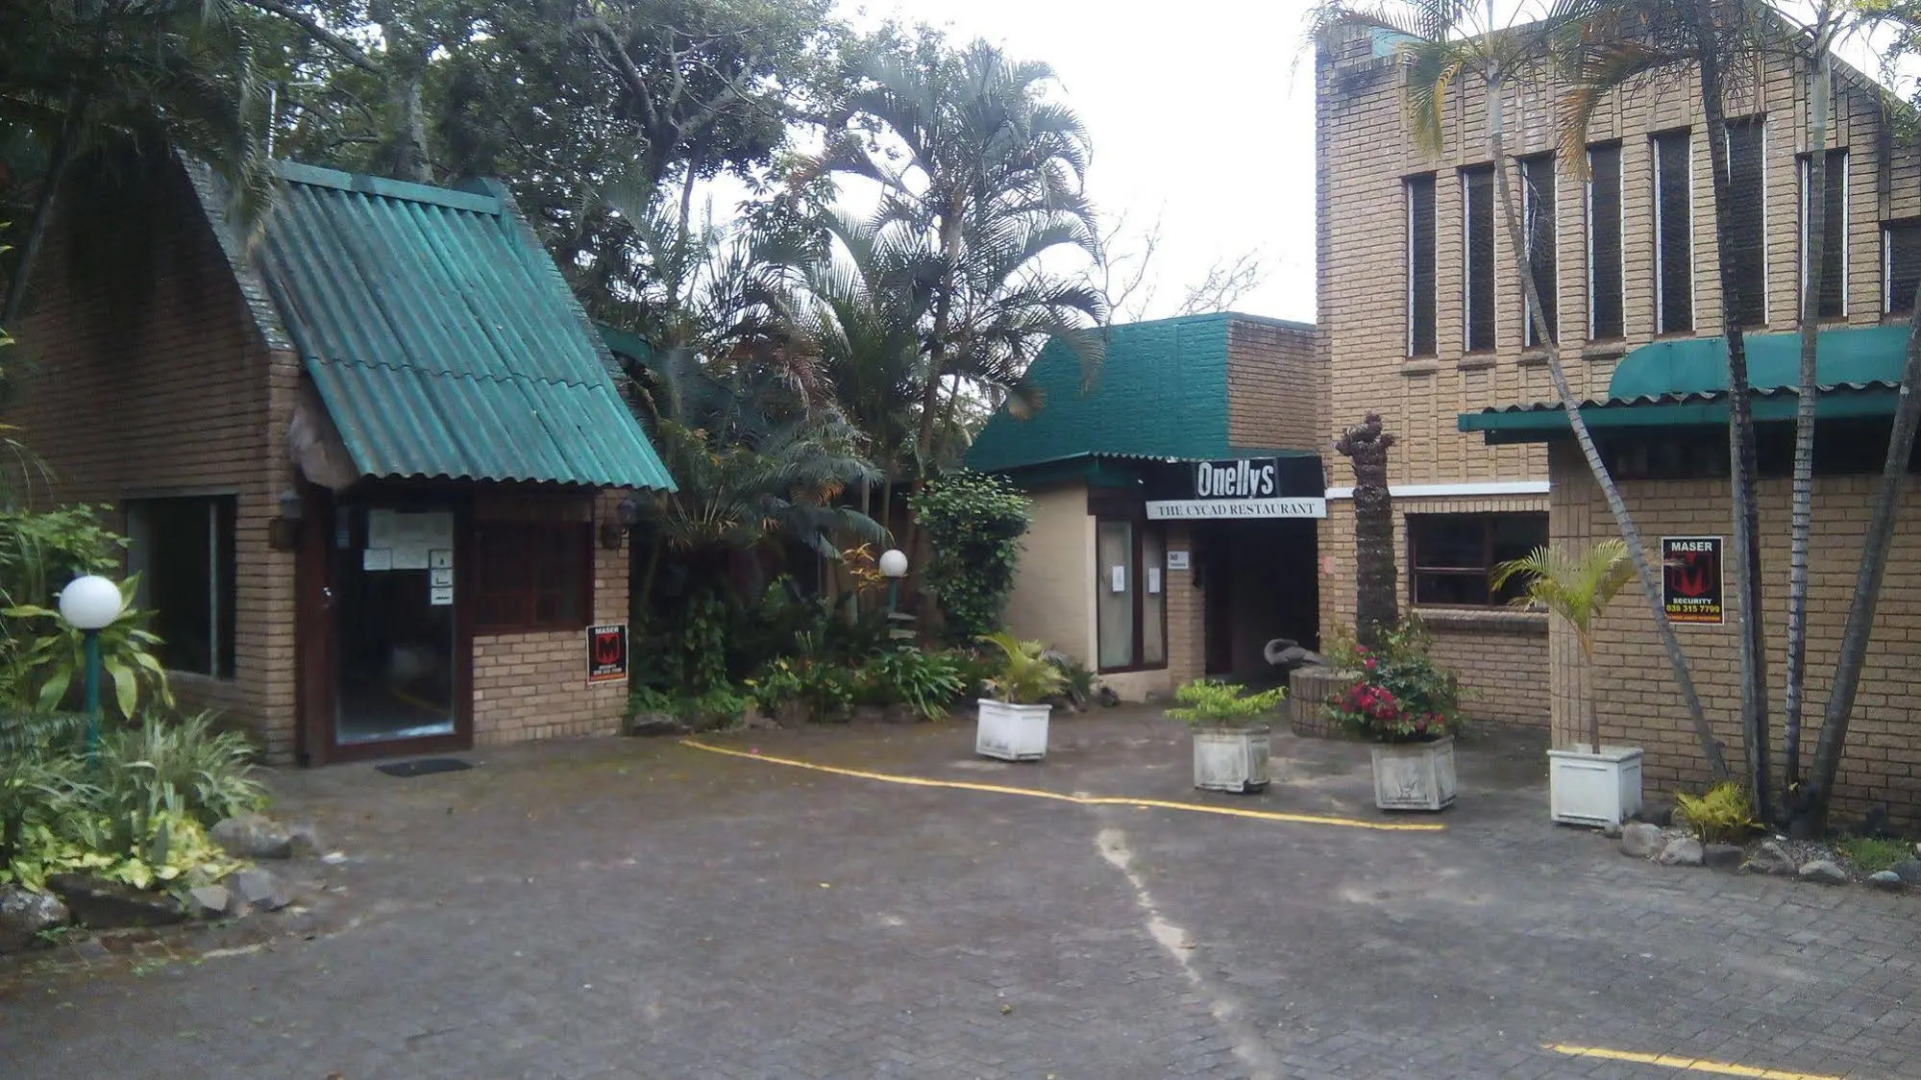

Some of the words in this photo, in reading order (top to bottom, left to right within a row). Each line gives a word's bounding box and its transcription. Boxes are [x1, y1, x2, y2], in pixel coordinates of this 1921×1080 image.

[1159, 505, 1182, 516] THE
[1186, 504, 1226, 516] CYCAD
[1230, 503, 1315, 515] RESTAURANT
[1671, 541, 1713, 552] MASER
